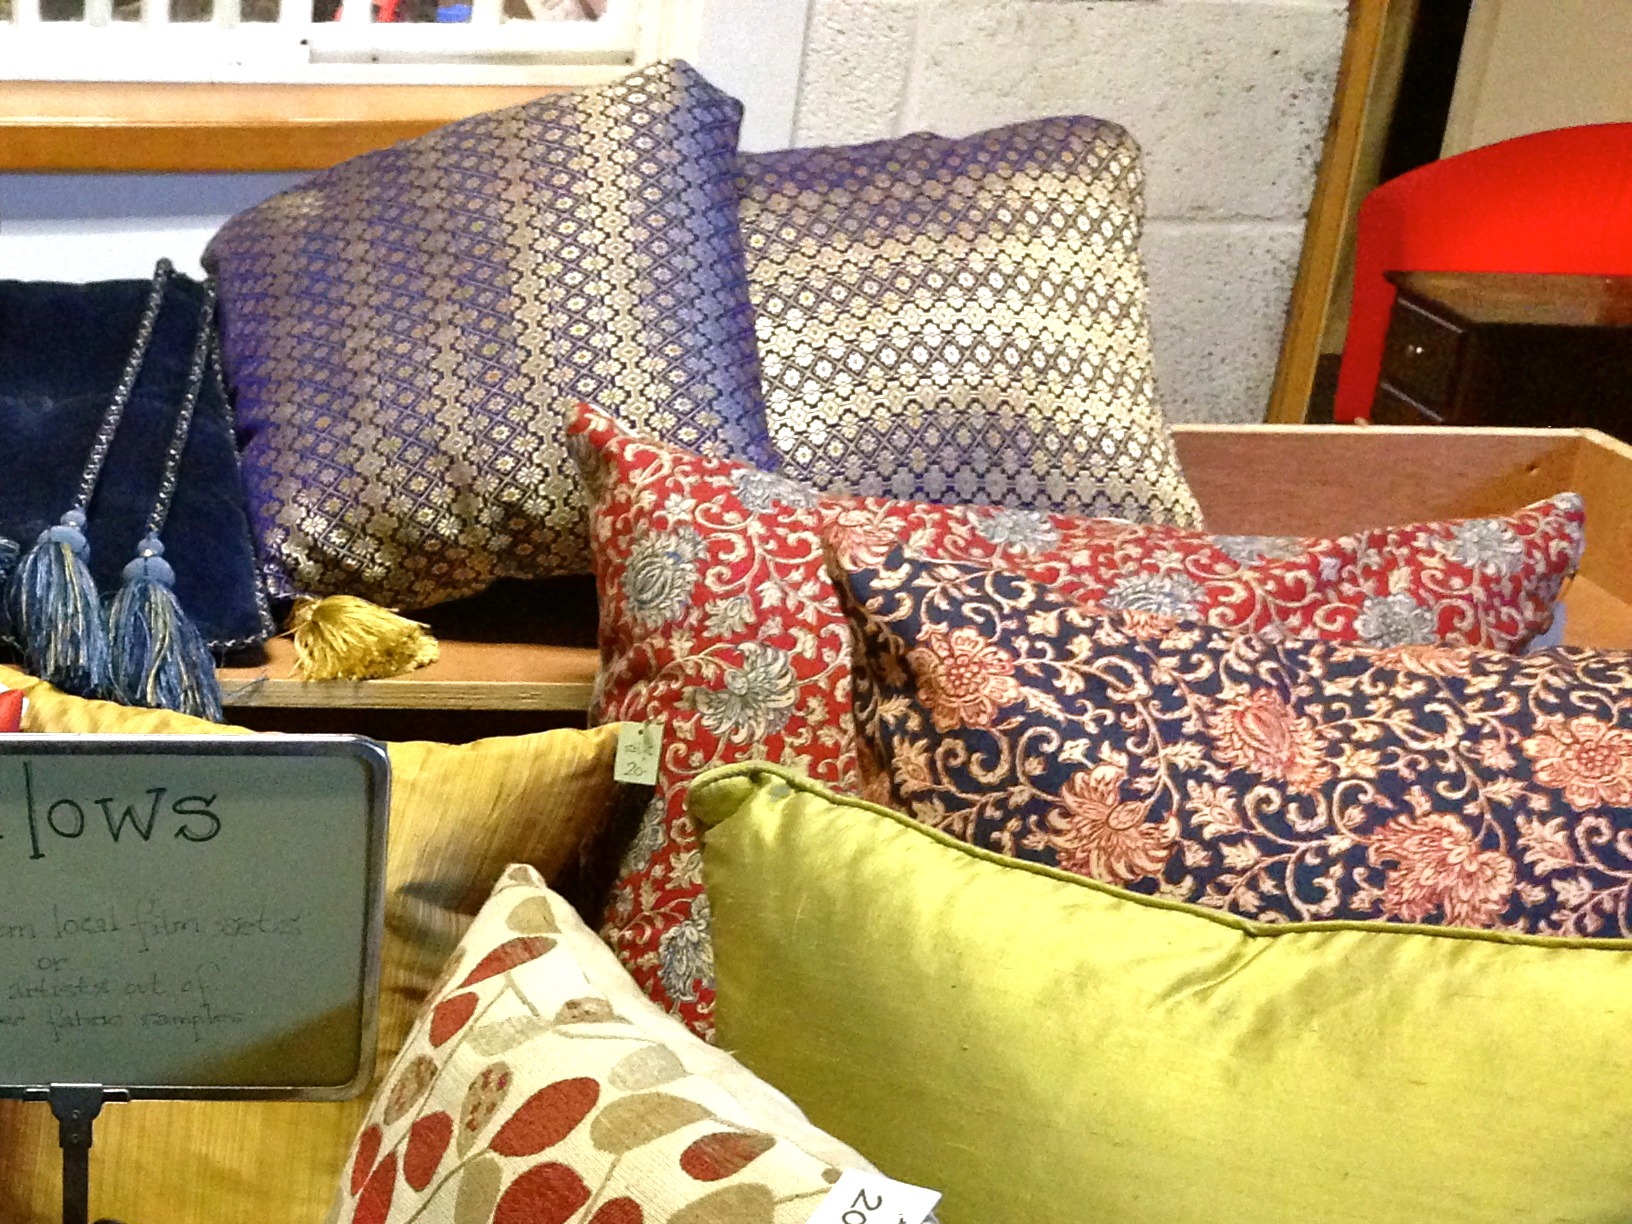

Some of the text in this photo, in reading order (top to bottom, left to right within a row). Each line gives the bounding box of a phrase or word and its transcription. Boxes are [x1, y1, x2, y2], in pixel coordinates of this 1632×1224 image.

[53, 902, 119, 940] local
[131, 898, 200, 954] film
[8, 976, 110, 1000] artists
[180, 959, 221, 1008] of
[36, 955, 69, 972] or
[138, 1004, 245, 1043] samples
